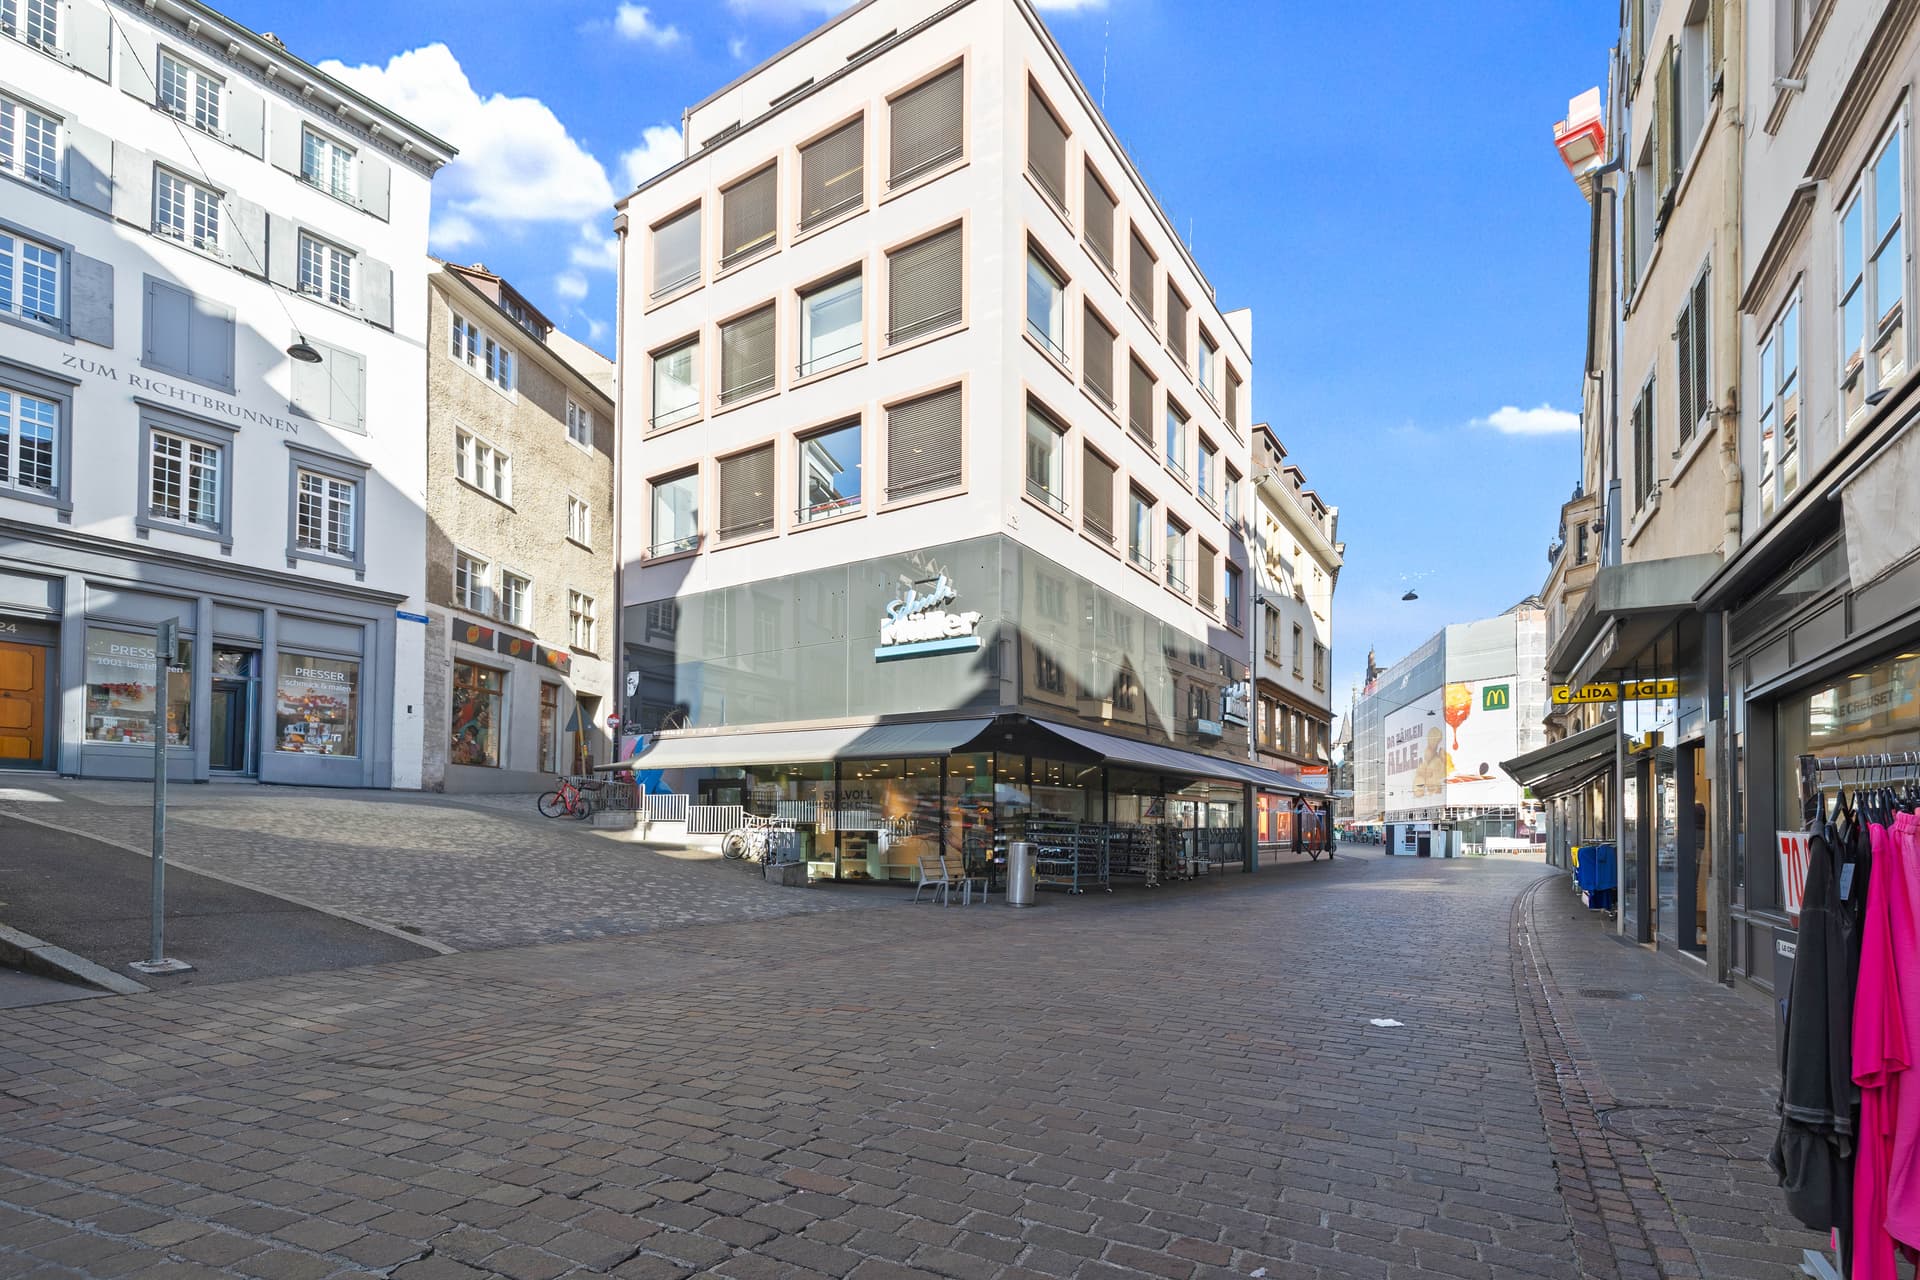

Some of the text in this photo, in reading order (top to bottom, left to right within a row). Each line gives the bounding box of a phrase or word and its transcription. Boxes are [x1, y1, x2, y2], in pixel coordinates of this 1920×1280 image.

[62, 353, 299, 435] ZUM RICHTBRUNNEN
[110, 644, 156, 659] PRESS
[295, 667, 345, 681] PRESSER
